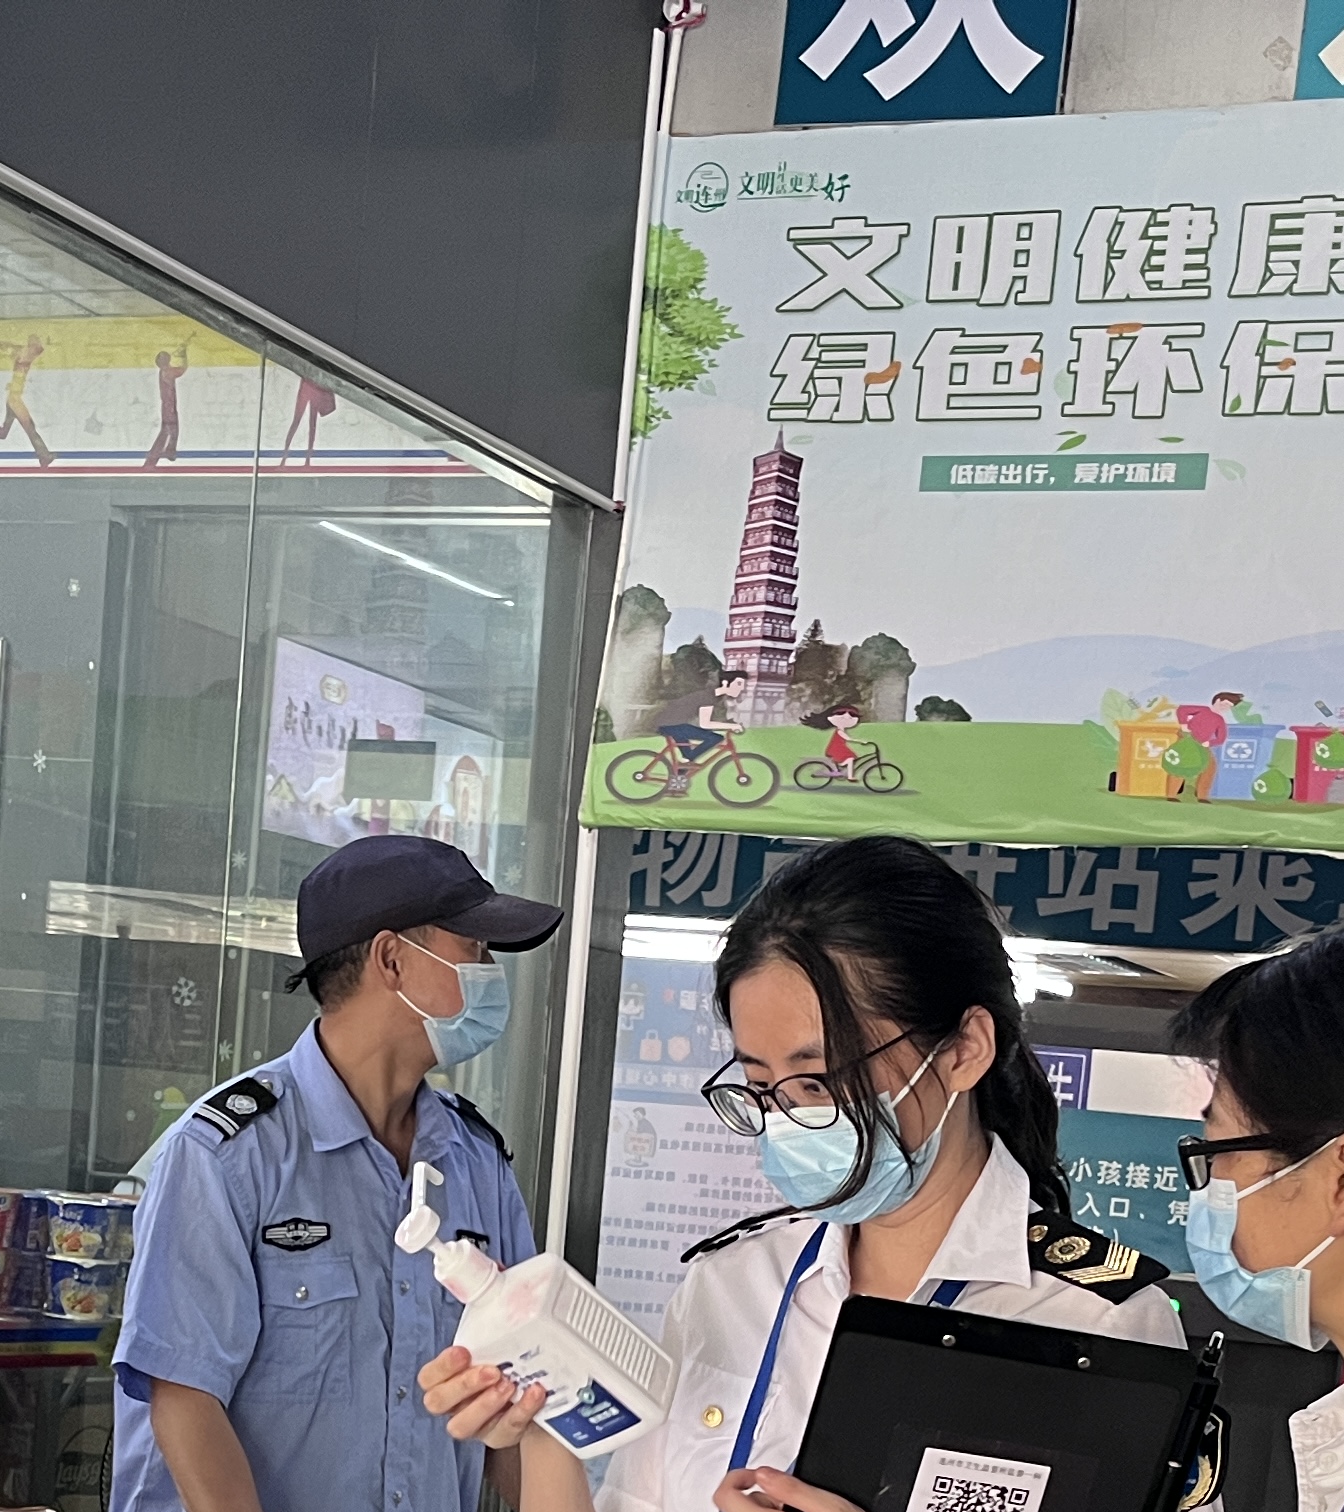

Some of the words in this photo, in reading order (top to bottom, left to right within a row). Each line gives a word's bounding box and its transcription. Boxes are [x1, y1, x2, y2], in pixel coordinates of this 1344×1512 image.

[949, 460, 1176, 489] 低碳出行，爱护环境
